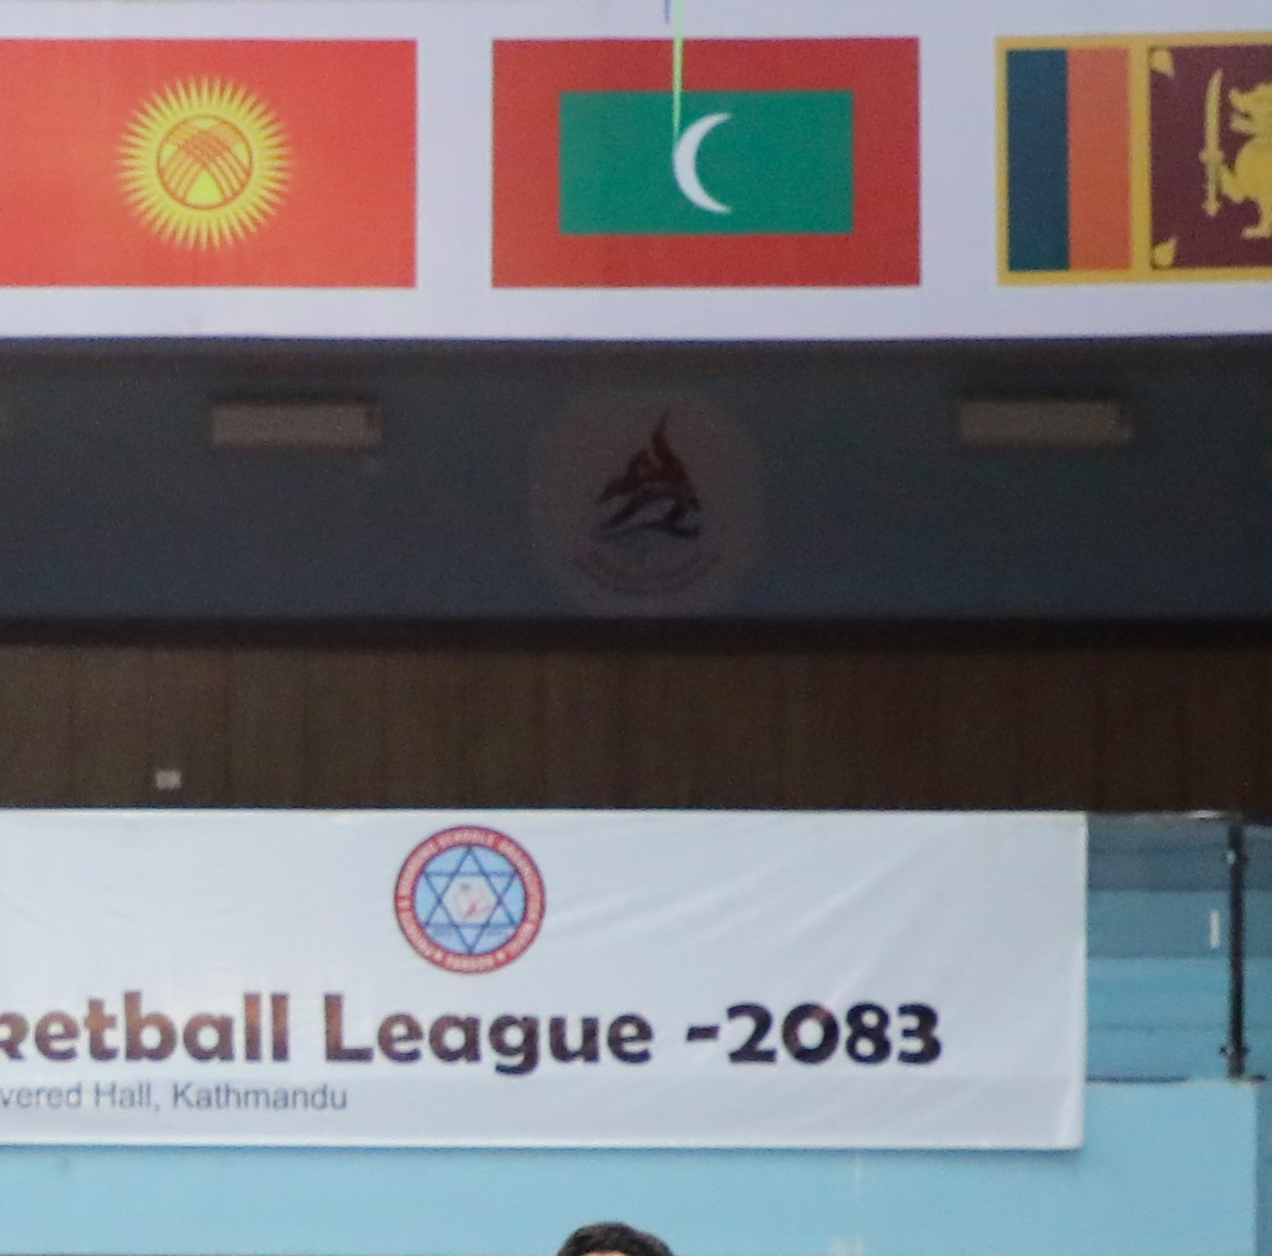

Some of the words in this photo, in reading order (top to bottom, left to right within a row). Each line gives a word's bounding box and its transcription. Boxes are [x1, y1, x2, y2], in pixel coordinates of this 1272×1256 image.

[324, 992, 654, 1075] League
[685, 1001, 943, 1066] -2083
[94, 1080, 161, 1113] Hall,
[172, 1080, 349, 1111] Kathmandu
